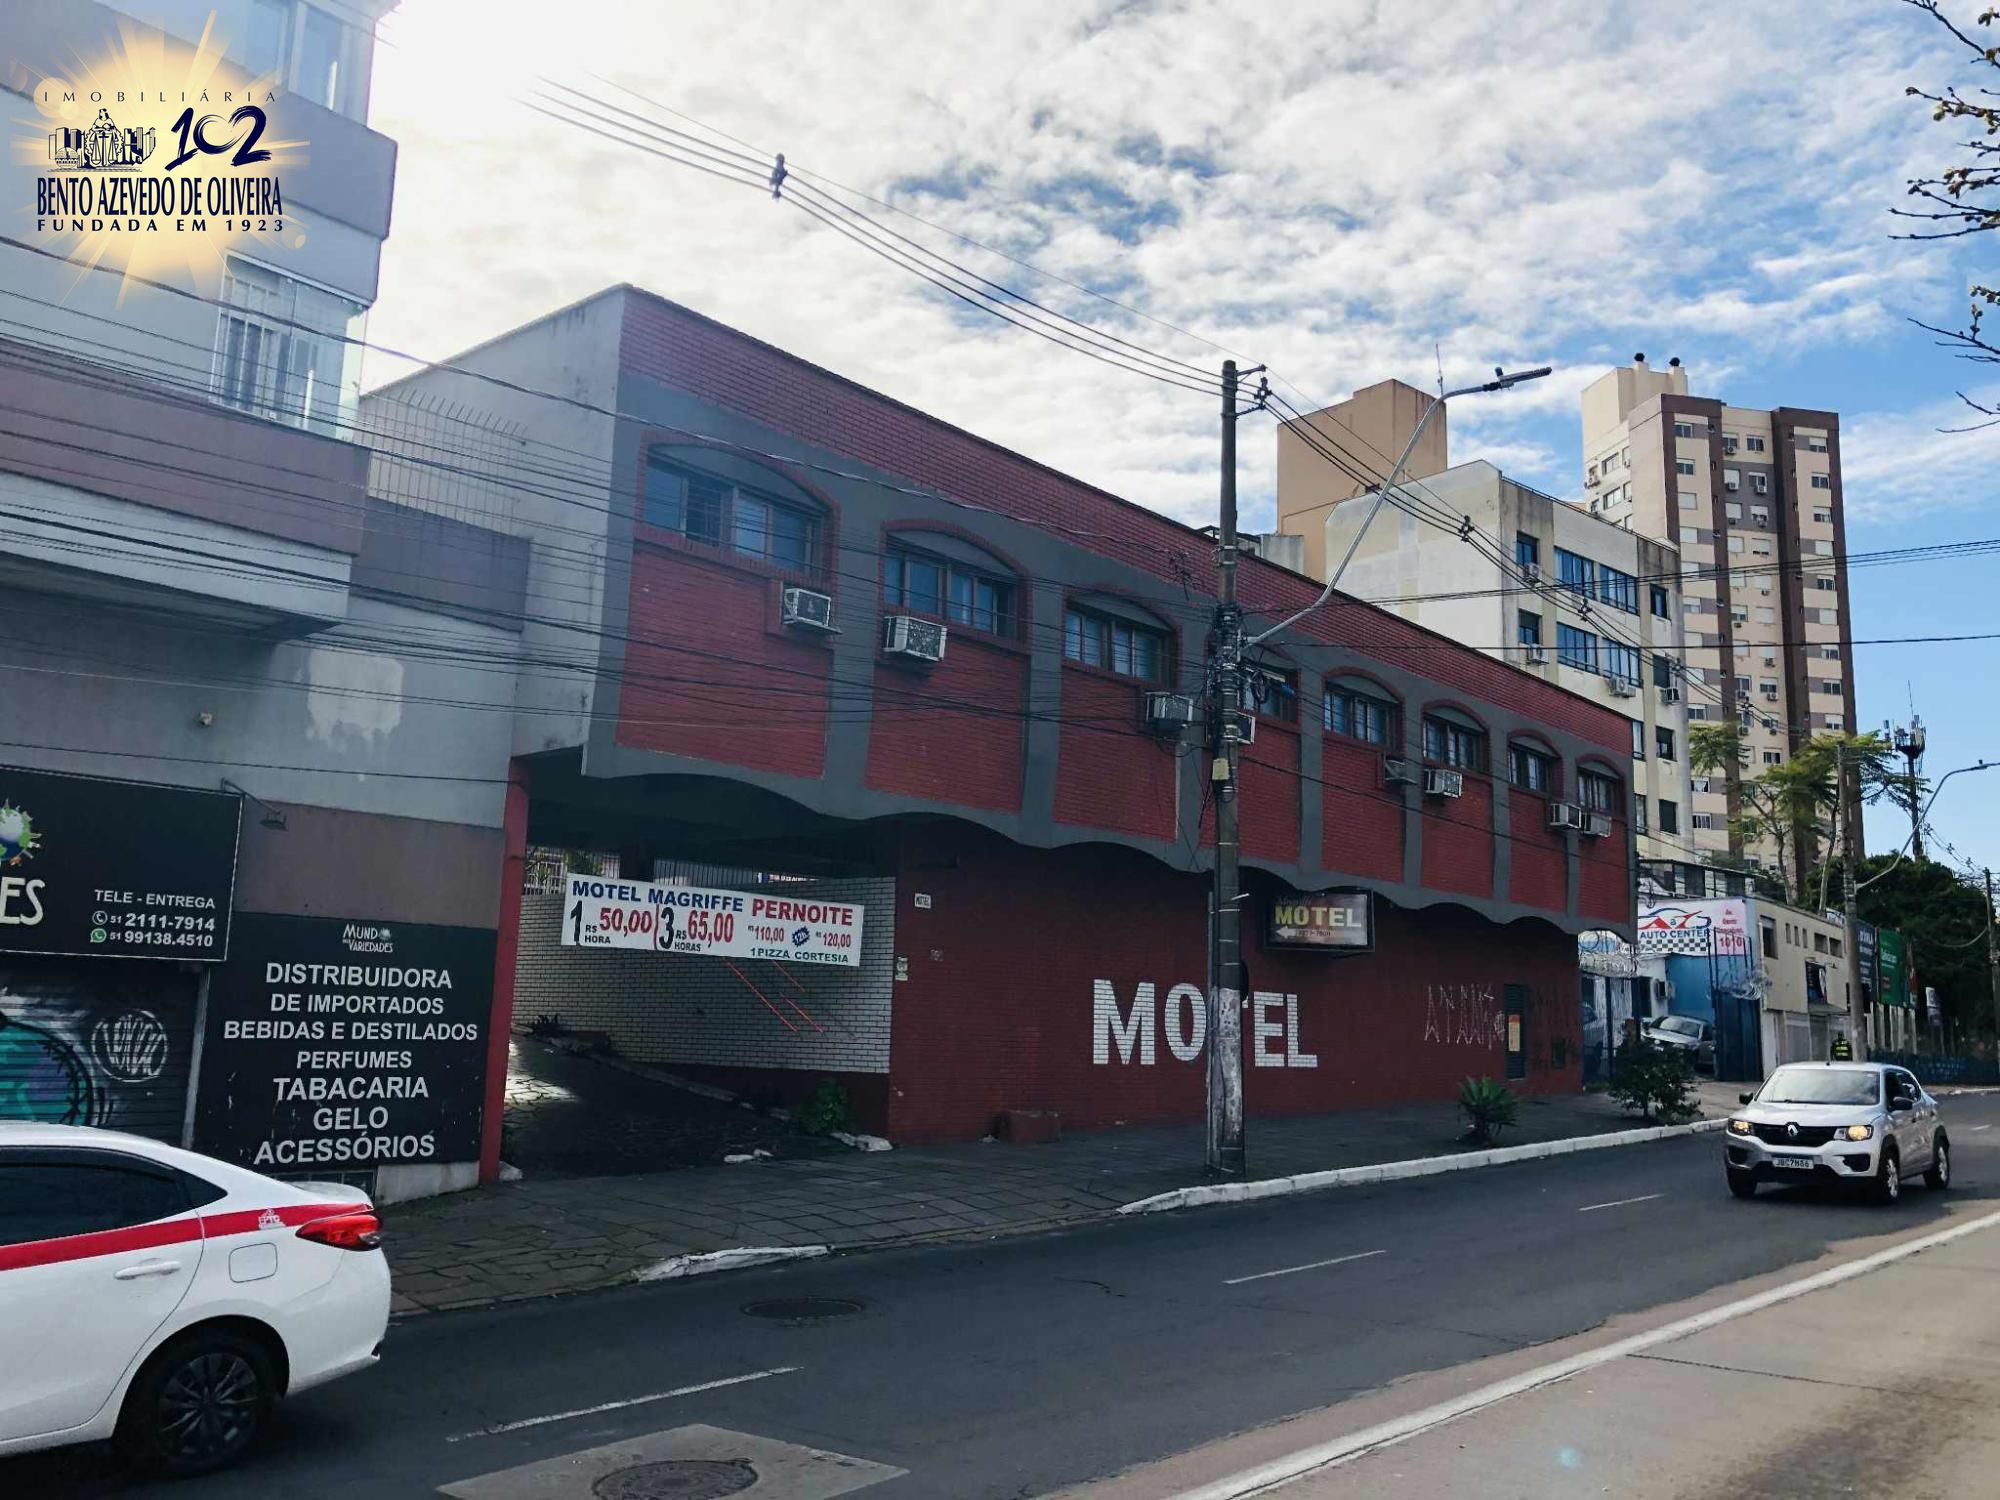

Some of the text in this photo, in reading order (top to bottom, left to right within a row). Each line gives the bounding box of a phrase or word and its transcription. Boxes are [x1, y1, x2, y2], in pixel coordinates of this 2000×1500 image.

[94, 889, 133, 904] TELE
[145, 893, 216, 909] ENTREGA
[572, 880, 854, 926] MOTEL MAGRIFFE PERNOITE
[110, 913, 216, 931] 51 2111-7914
[570, 899, 584, 944] 1
[599, 907, 653, 938] 50,00
[658, 906, 675, 950] 3
[687, 909, 734, 948] 65,00
[1276, 906, 1362, 927] MOTEL
[109, 930, 213, 947] 51 99138.4510
[584, 935, 702, 952] HORA HORAS
[1640, 931, 1668, 940] AUTO
[757, 948, 791, 959] PIZZA
[794, 951, 849, 963] CORTESIA
[265, 962, 453, 989] DISTRIBUIDORA
[270, 993, 445, 1015] DE IMPORTADOS
[224, 1020, 478, 1041] BEBIDAS E DESTILADOS
[1093, 979, 1318, 1067] MOEL
[297, 1050, 413, 1070] PERFUMES
[273, 1076, 430, 1102] TABACARIA
[313, 1106, 389, 1131] GELO
[254, 1130, 436, 1166] ACESSÓRIOS
